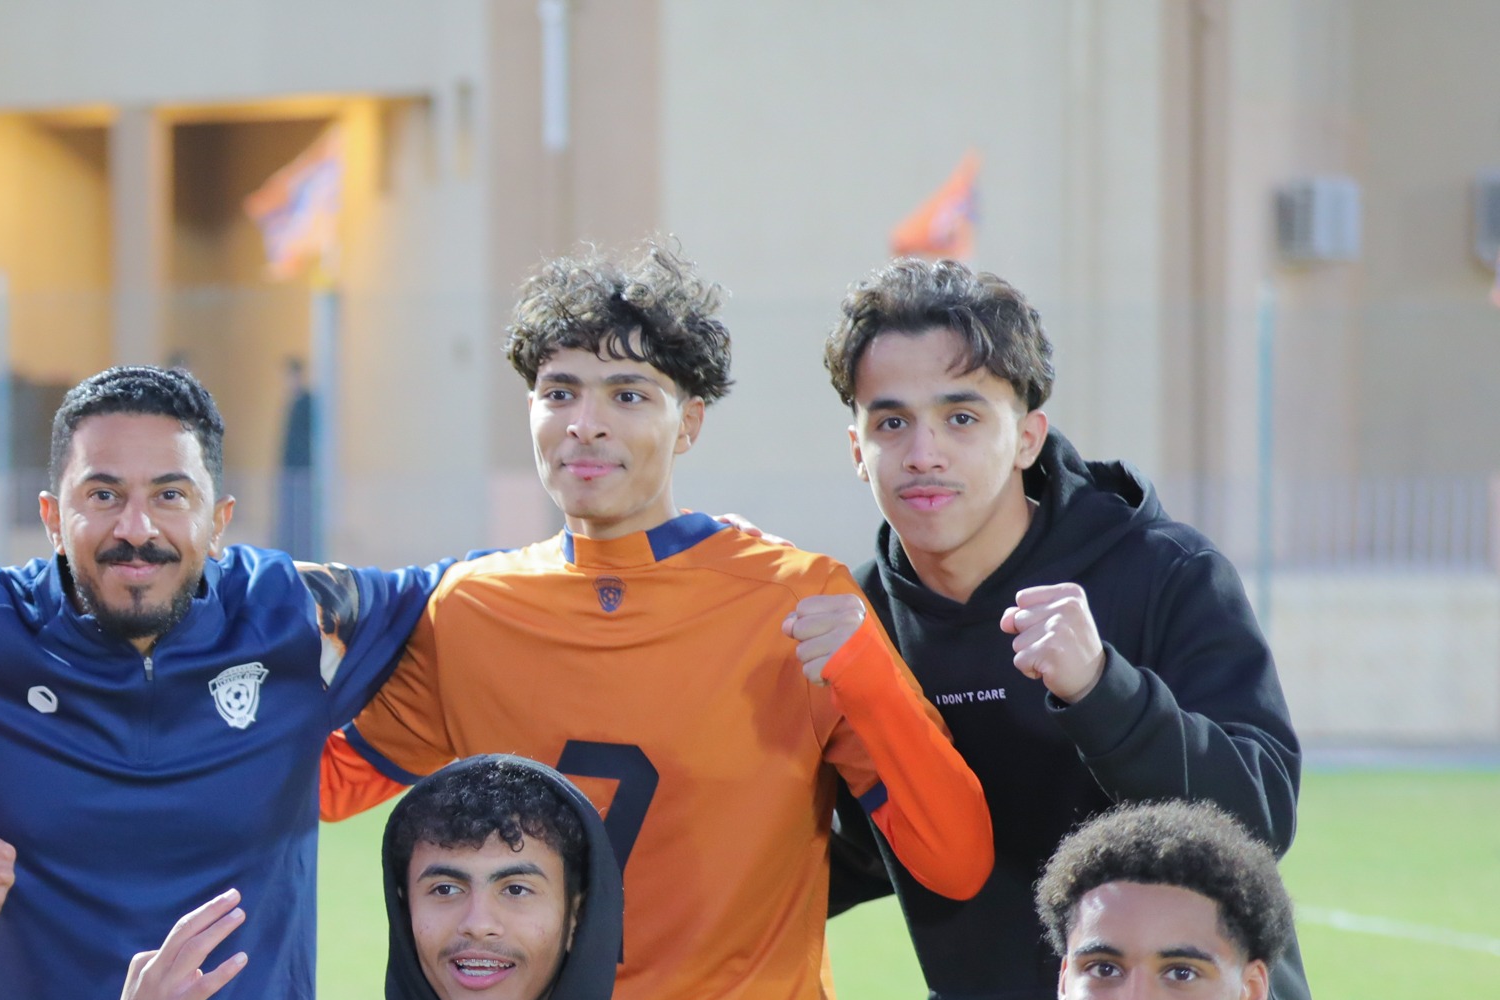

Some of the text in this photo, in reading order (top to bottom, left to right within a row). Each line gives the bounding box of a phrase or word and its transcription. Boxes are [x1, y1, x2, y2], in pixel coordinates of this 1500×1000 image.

[936, 688, 1006, 705] I DON'T CARE
[556, 740, 659, 874] 7
